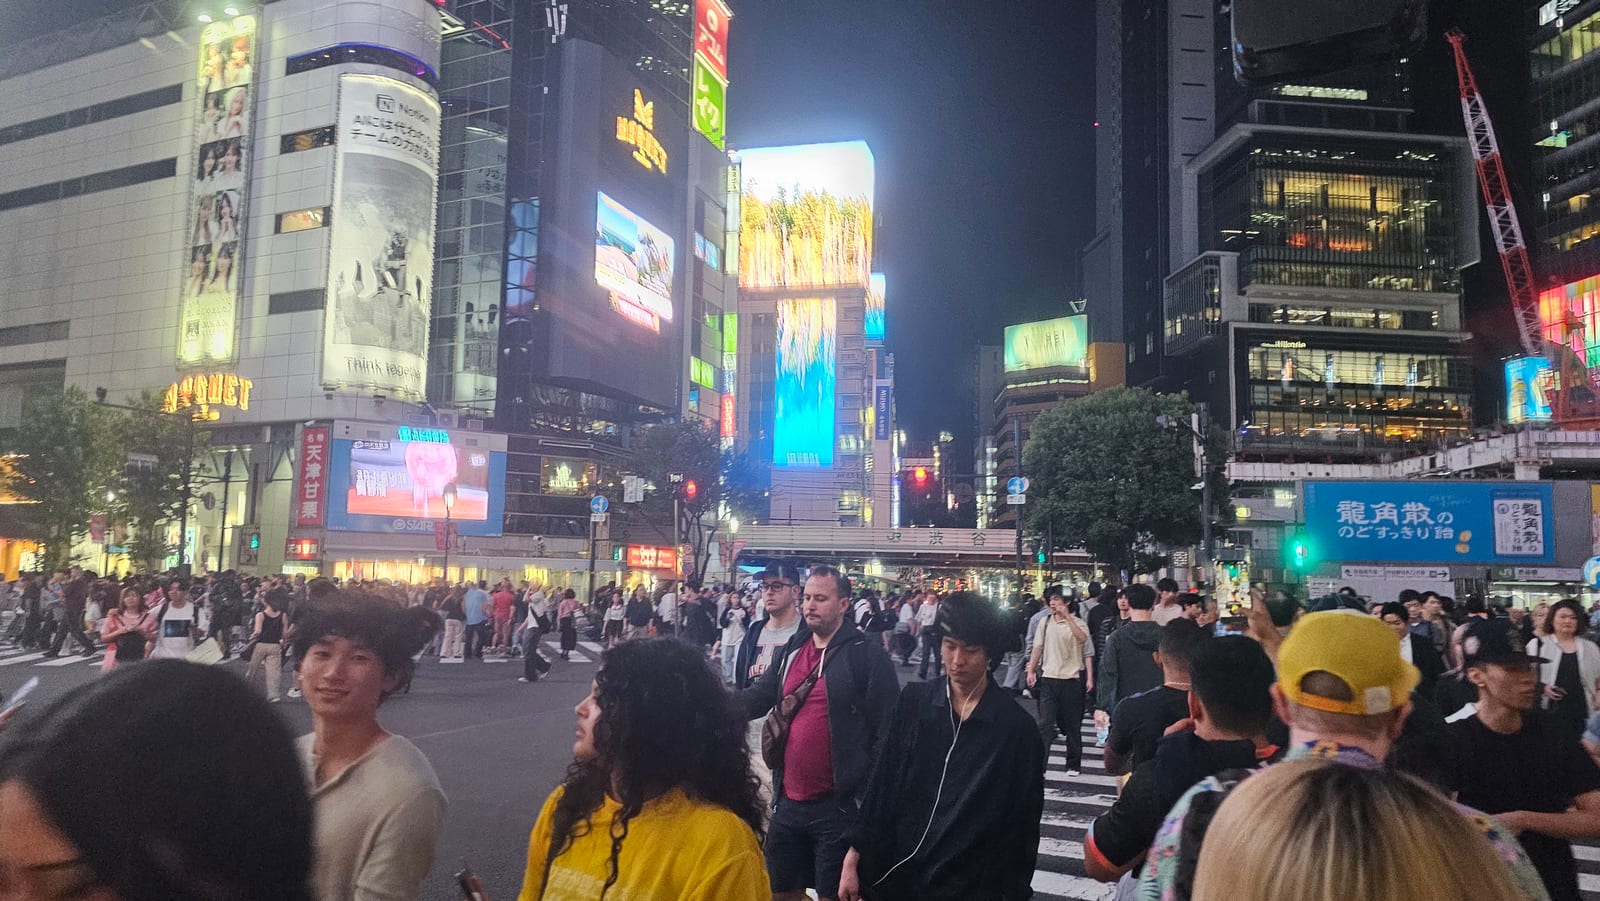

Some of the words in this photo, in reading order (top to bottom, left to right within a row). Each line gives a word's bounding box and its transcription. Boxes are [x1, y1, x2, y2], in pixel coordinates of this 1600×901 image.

[344, 356, 382, 375] Think
[301, 444, 323, 519] 天津甘栗
[1336, 500, 1455, 526] 龍角散の
[1337, 525, 1455, 540] のどすっきり飴
[1499, 567, 1513, 577] JR
